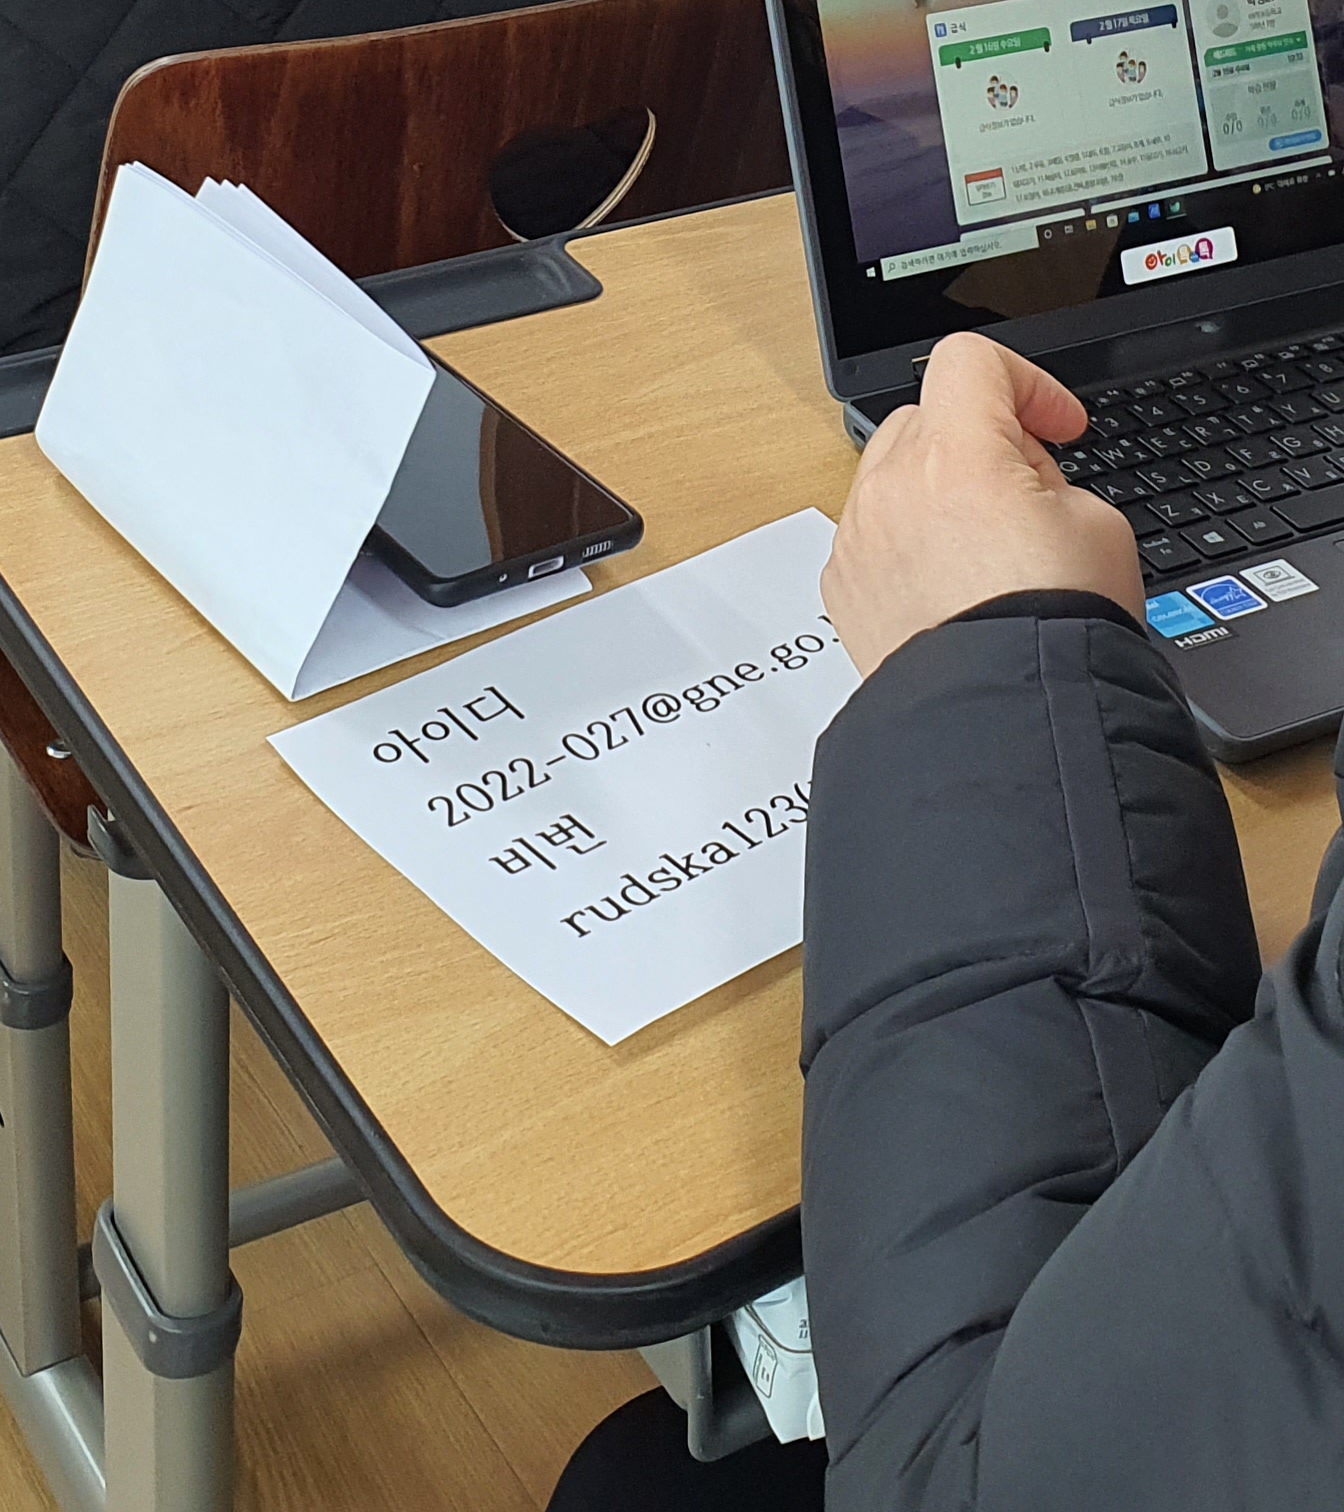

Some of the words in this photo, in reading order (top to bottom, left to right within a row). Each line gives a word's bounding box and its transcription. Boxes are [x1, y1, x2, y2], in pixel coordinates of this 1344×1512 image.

[1174, 626, 1230, 648] HDMI
[372, 685, 526, 765] 아이디
[426, 614, 840, 828] 2022-027@gne.go.
[488, 813, 608, 875] 비번
